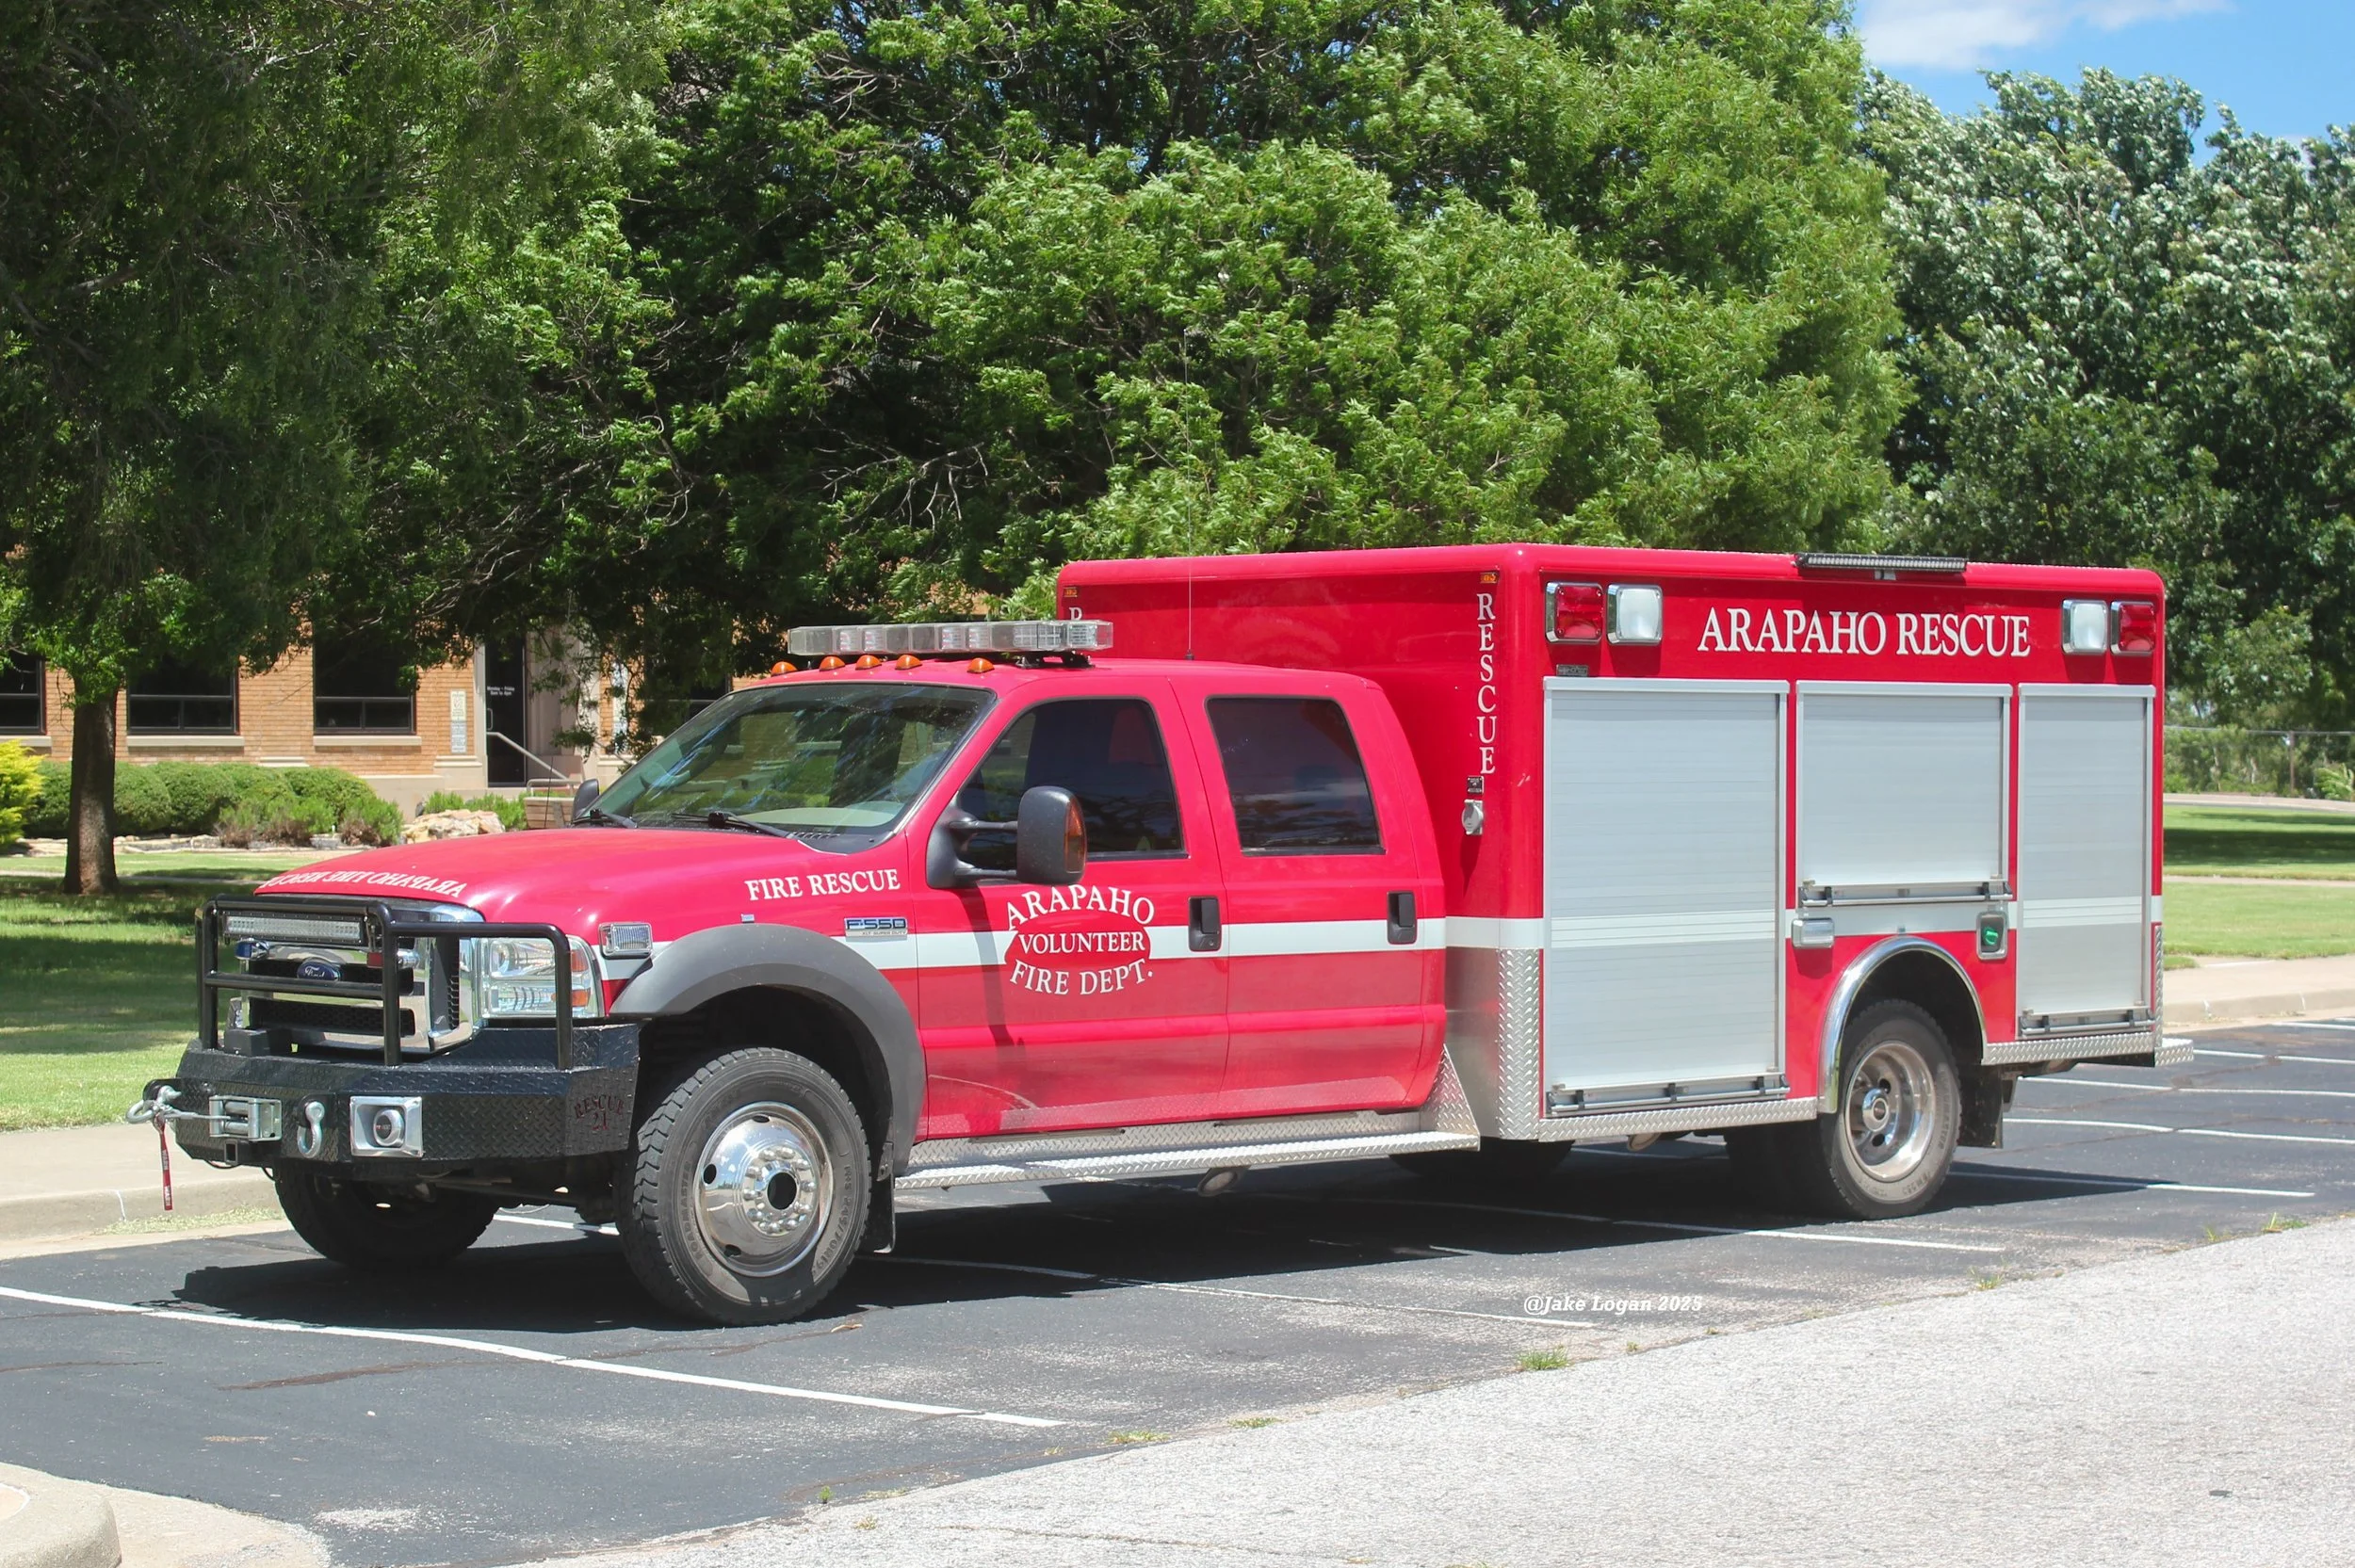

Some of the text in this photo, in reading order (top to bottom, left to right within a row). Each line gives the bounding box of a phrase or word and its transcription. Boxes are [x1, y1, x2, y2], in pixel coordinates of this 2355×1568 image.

[1697, 606, 2031, 656] ARAPAHO RESCUE
[1477, 592, 1496, 774] RESCUE
[744, 868, 901, 901] FIRE RESCUE
[1007, 884, 1155, 931] ARAPAHO
[1018, 931, 1145, 954] VOLUNTEER
[1010, 959, 1153, 995] FIRE DEPT.
[574, 1094, 624, 1120] RESCUE
[592, 1112, 609, 1131] 21
